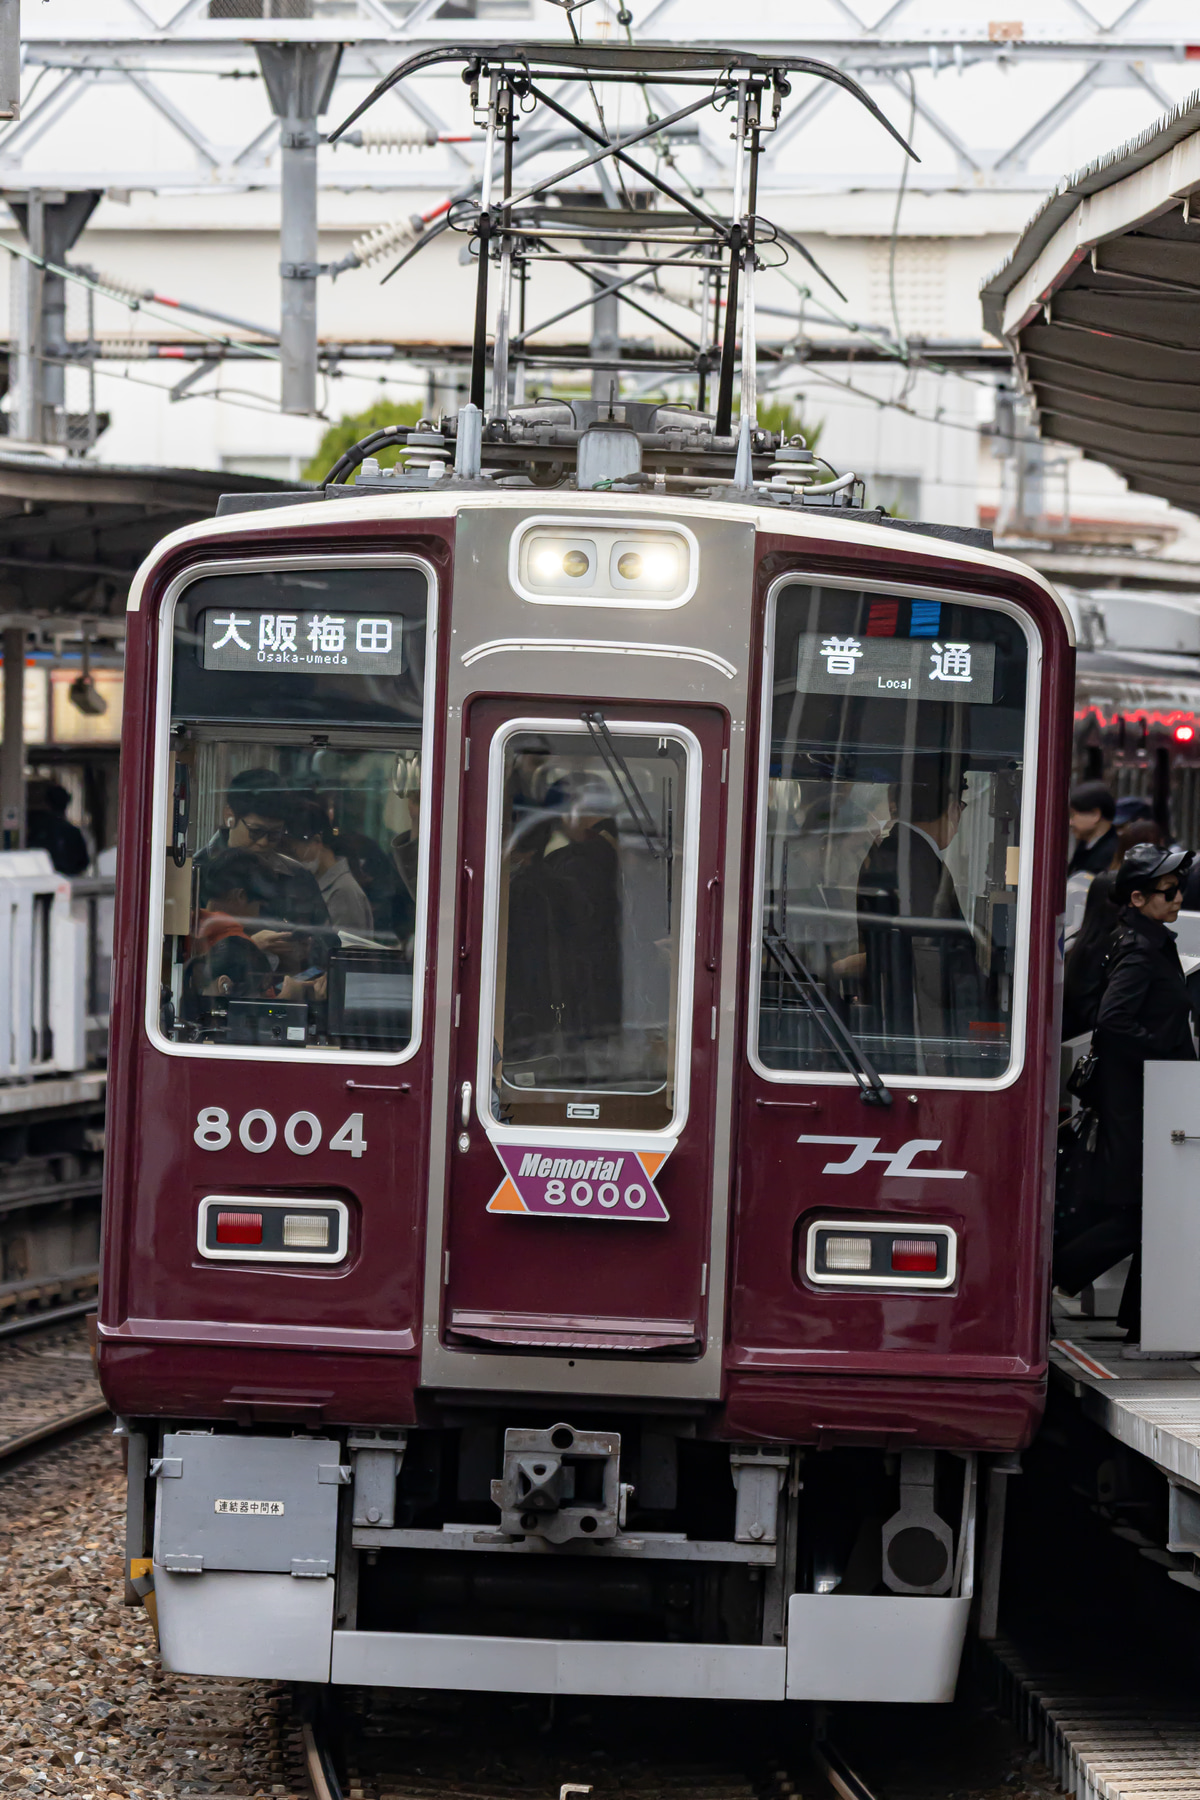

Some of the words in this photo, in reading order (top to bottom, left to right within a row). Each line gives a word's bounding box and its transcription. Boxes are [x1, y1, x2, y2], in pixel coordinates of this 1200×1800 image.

[212, 612, 393, 654] 大阪梅田
[257, 651, 348, 665] Osaka-umeda
[819, 636, 973, 683] 普通
[877, 676, 912, 690] Local
[193, 1106, 368, 1158] 8004
[518, 1152, 625, 1182] Memorial
[544, 1179, 647, 1210] 8000
[218, 1500, 280, 1514] 連結器中間体
